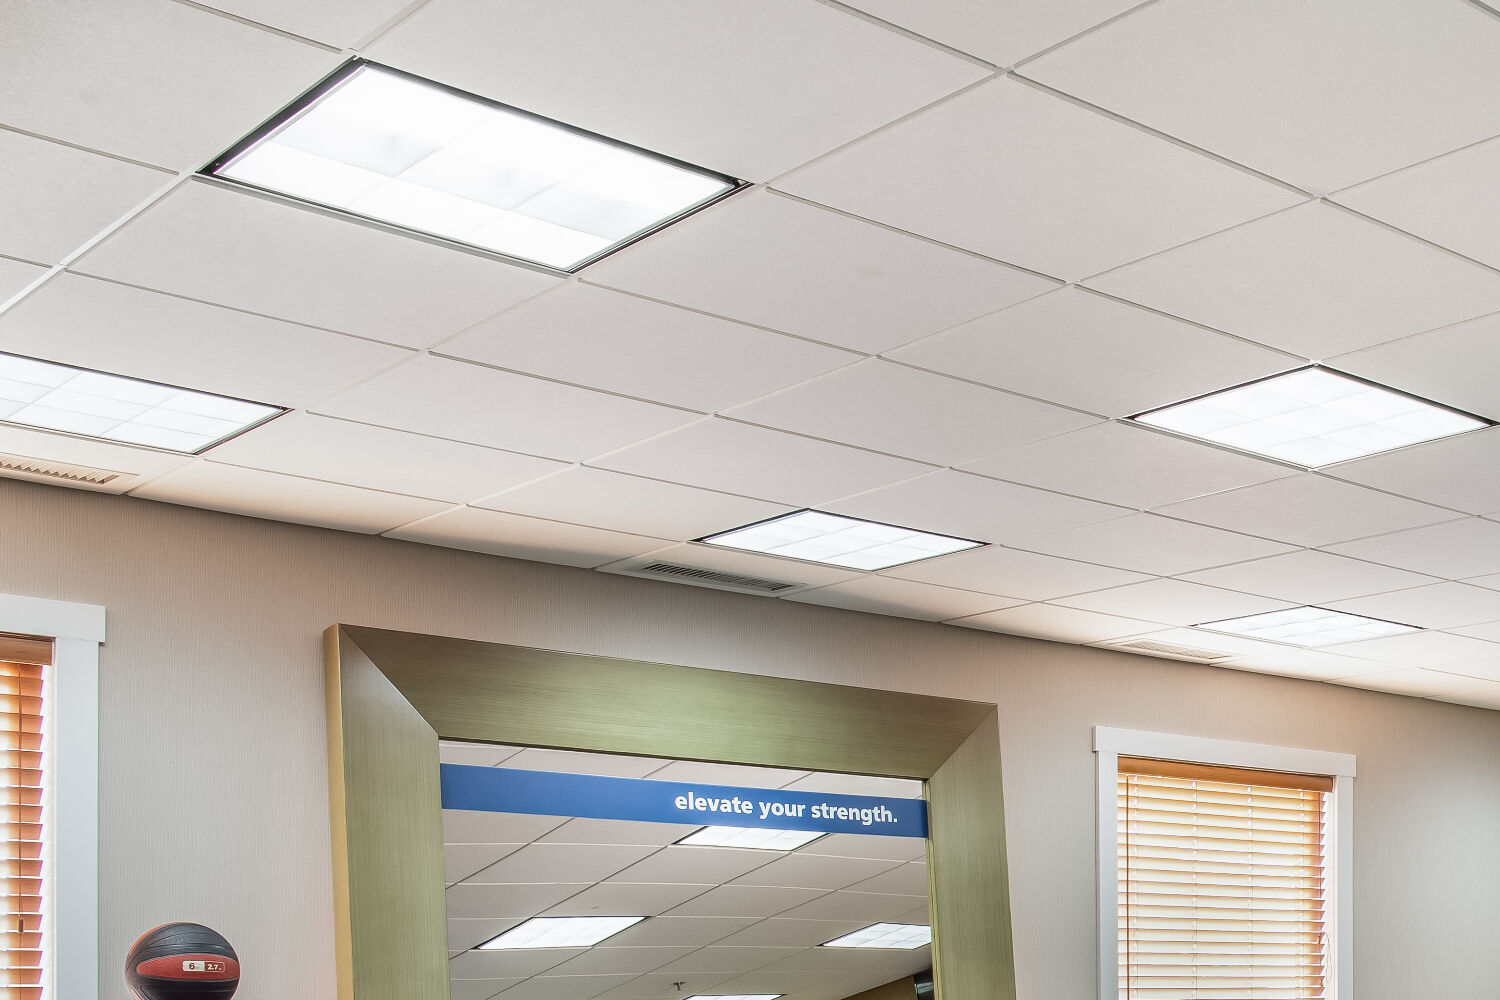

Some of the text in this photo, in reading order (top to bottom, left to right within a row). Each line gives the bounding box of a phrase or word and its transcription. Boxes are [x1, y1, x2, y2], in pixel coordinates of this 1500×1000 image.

[674, 792, 898, 825] elevate your strength.
[207, 963, 219, 971] 2.7
